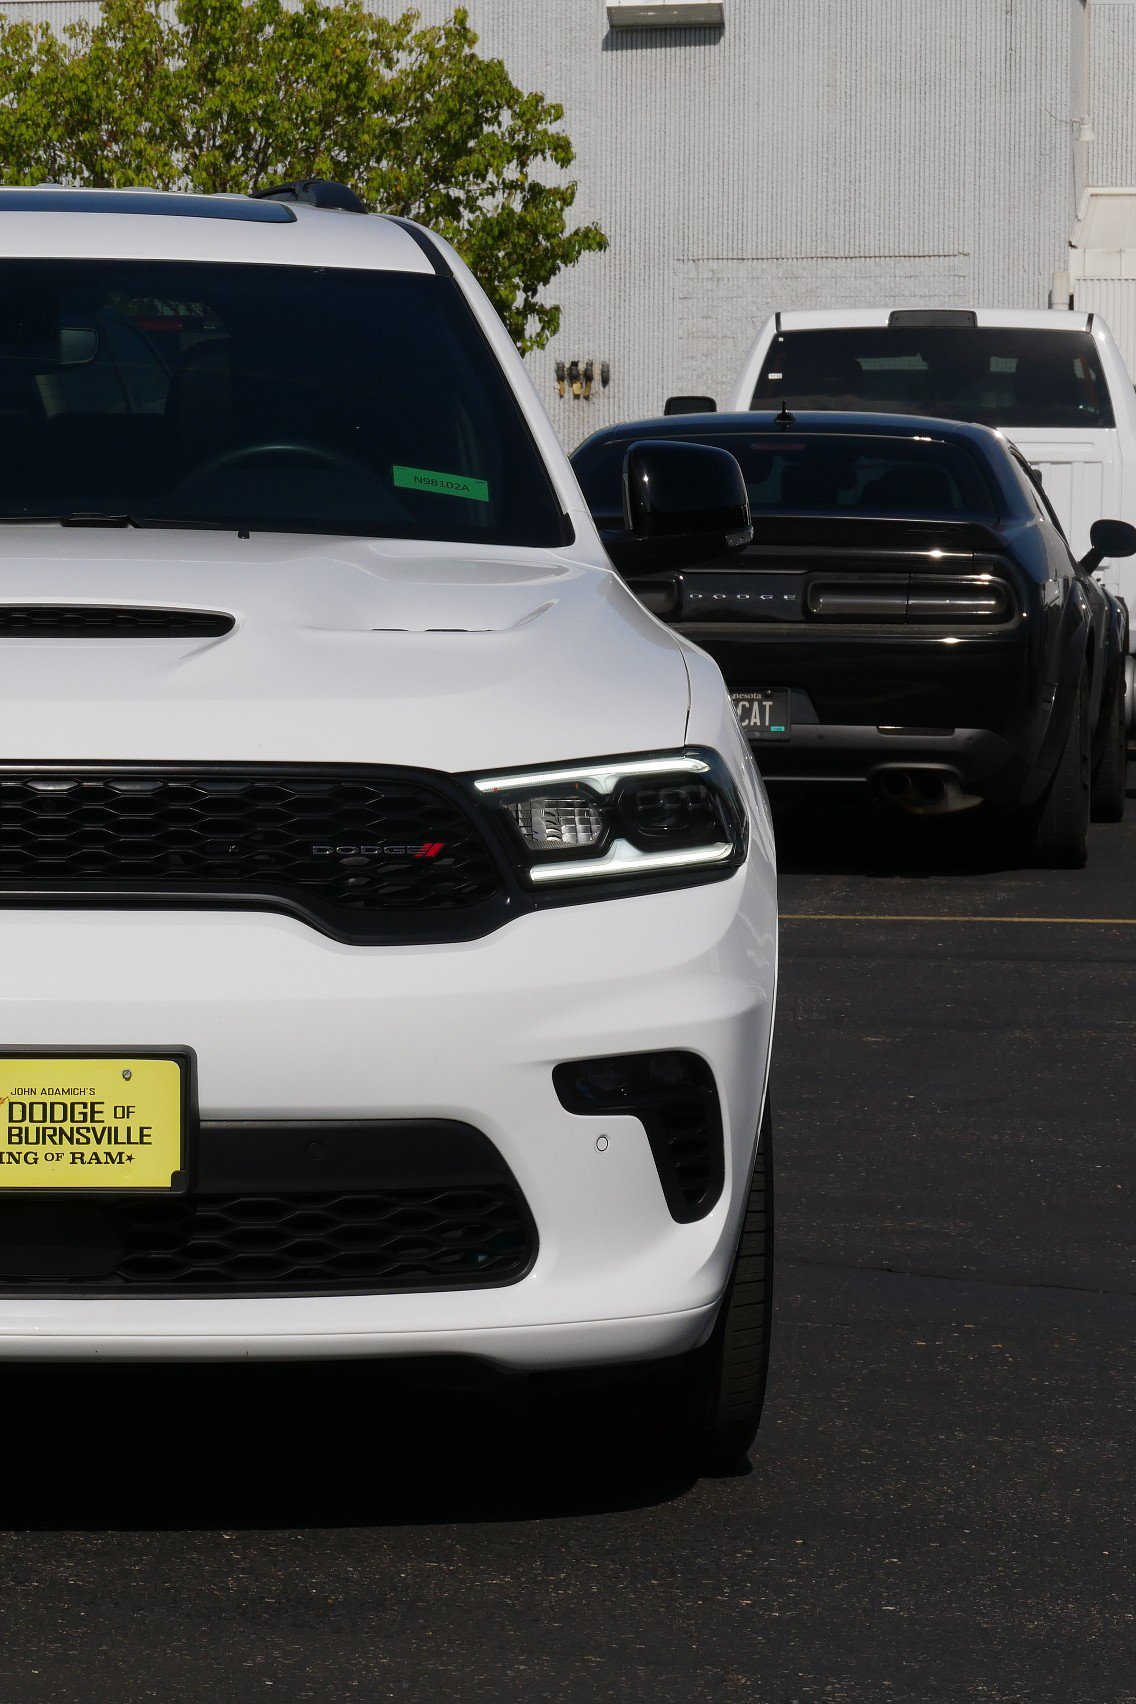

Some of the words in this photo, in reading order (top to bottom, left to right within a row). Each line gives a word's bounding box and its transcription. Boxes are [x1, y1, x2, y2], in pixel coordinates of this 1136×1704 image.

[414, 476, 470, 492] N98102A
[312, 845, 428, 855] DODGE
[11, 1087, 37, 1096] JOHN
[40, 1087, 96, 1096] ADAMICH'S
[8, 1101, 105, 1124] DODGE
[113, 1105, 136, 1120] OF
[7, 1126, 152, 1146] BURNSVILLE
[44, 1152, 65, 1162] OF
[69, 1151, 125, 1165] RAM
